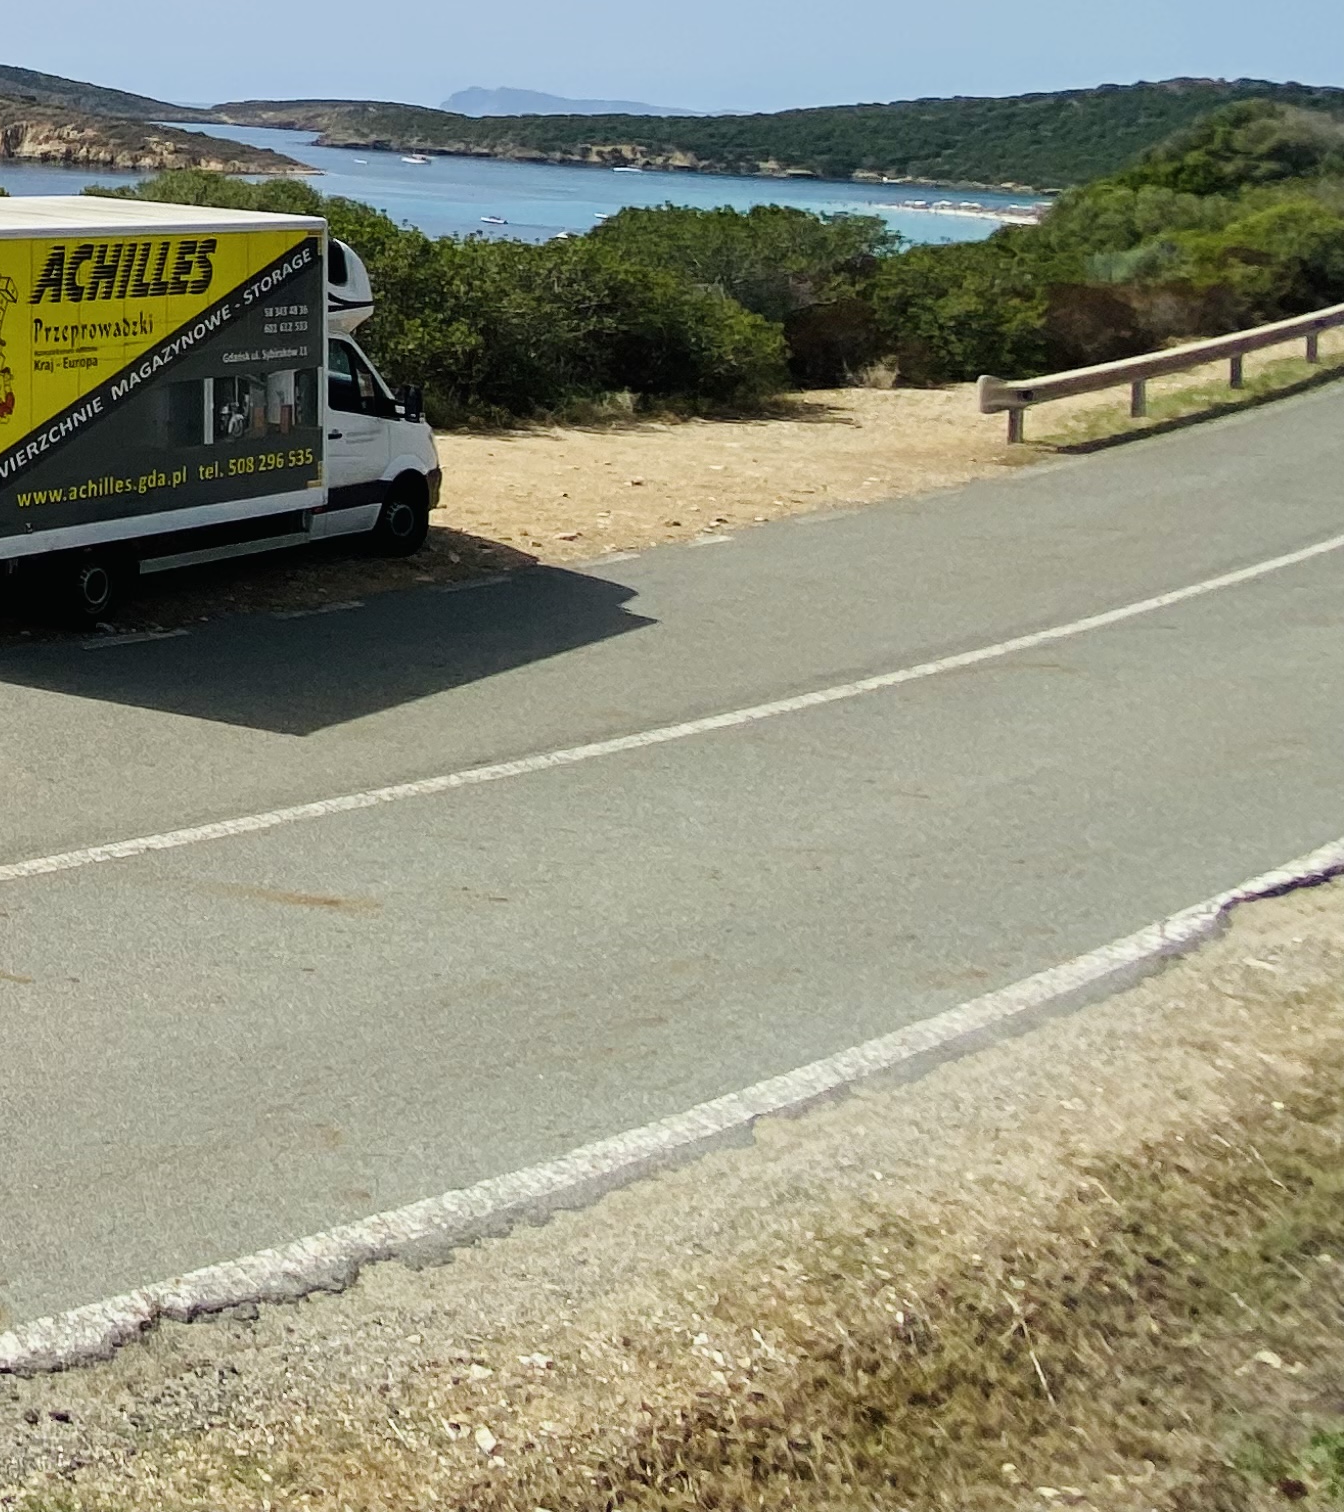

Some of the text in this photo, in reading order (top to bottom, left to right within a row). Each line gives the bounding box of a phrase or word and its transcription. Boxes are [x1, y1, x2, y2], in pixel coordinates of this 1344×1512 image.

[27, 238, 217, 304] ACHILLES
[33, 311, 153, 347] Przeprowadzki
[111, 304, 232, 401] MAGAZYNOWE
[243, 248, 312, 305] STORAGE
[34, 359, 53, 373] Kraj
[63, 357, 98, 370] Europa
[199, 448, 313, 480] tel. 508 296 535
[17, 466, 187, 507] www.achilles.gda.pl
